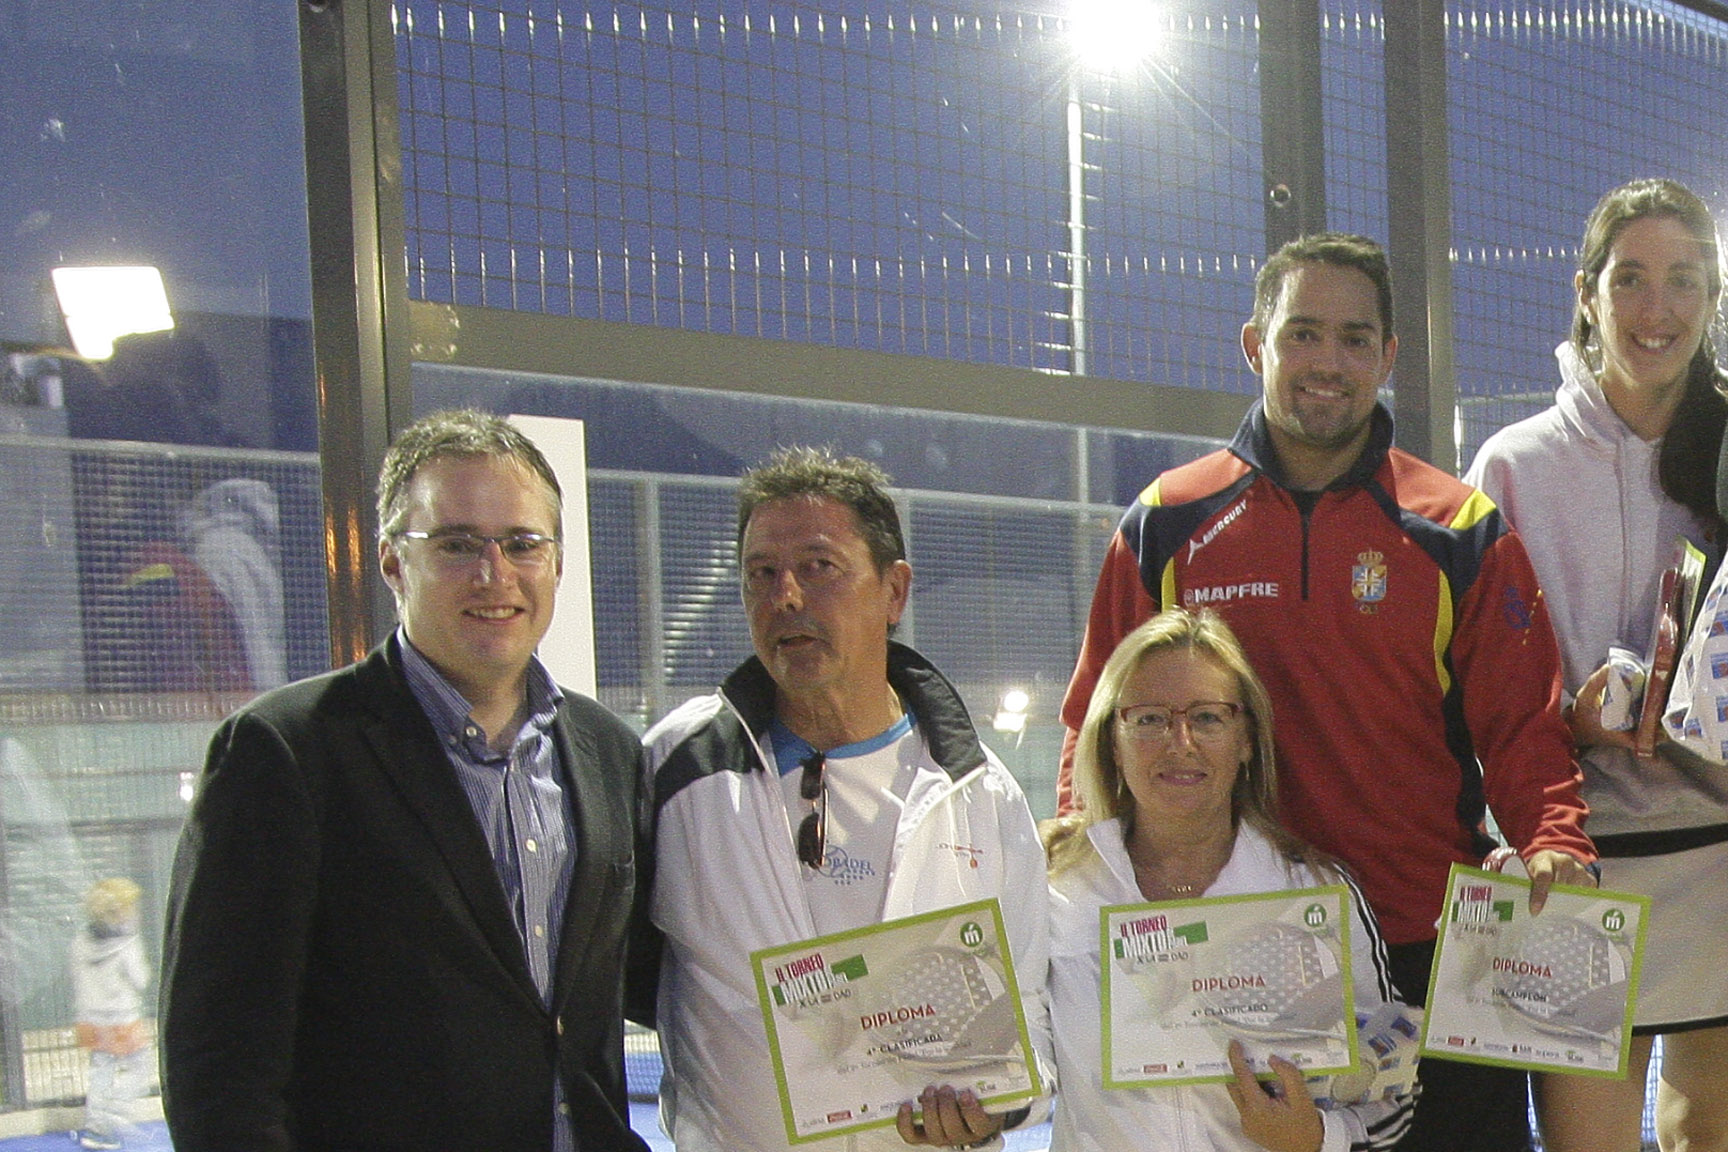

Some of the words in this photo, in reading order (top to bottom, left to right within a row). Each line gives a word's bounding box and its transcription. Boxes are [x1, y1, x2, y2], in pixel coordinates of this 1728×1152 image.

[1203, 499, 1247, 545] MERCURY
[1194, 582, 1279, 603] MAPFRE
[785, 953, 824, 980] TORNEO
[1493, 957, 1552, 978] DIPLOMA
[1192, 975, 1265, 992] DIPLOMA
[860, 1003, 936, 1030] DIPLOMA
[880, 1033, 944, 1053] CLASIFICADA
